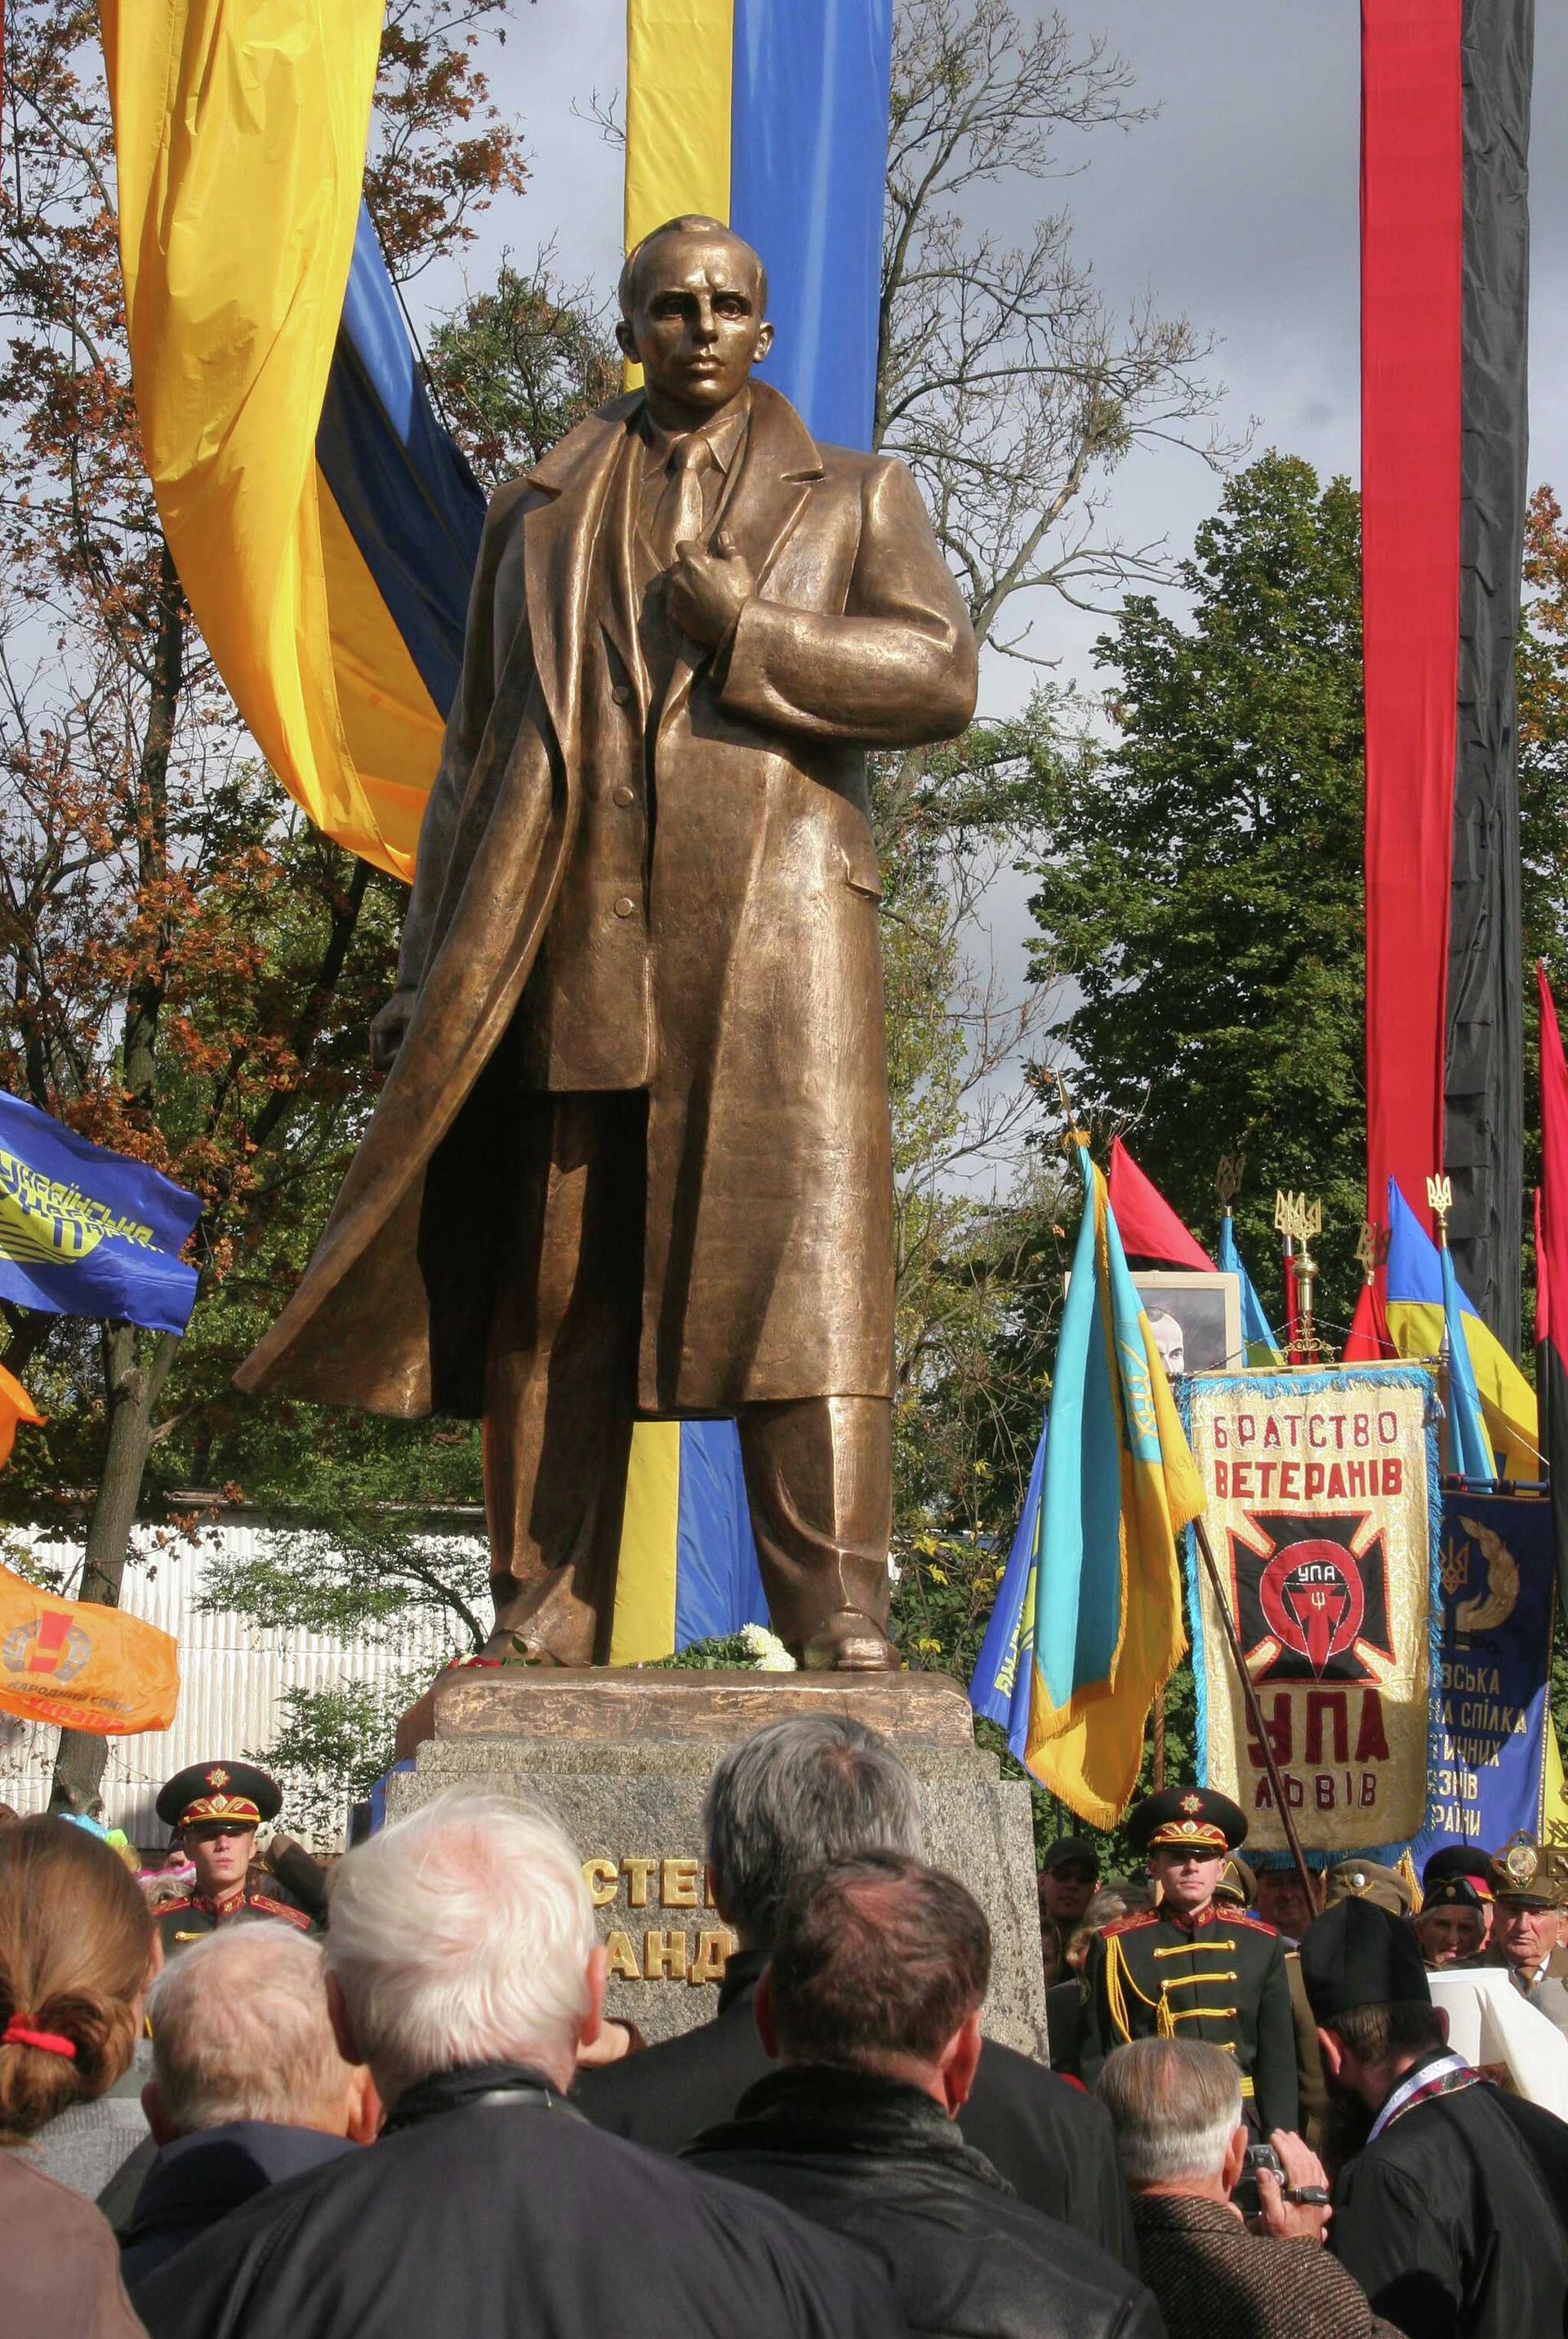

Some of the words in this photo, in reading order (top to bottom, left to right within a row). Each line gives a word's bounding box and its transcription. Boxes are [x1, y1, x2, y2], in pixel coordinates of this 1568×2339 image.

[1214, 1411, 1397, 1450] БРАТСТВО
[1214, 1459, 1402, 1500] ВЕТЕРАНІВ
[1298, 1565, 1335, 1581] УПА
[1245, 1688, 1389, 1768] УПА
[1254, 1771, 1376, 1811] ЛЬВІВ
[582, 1859, 716, 1909] СТЕ
